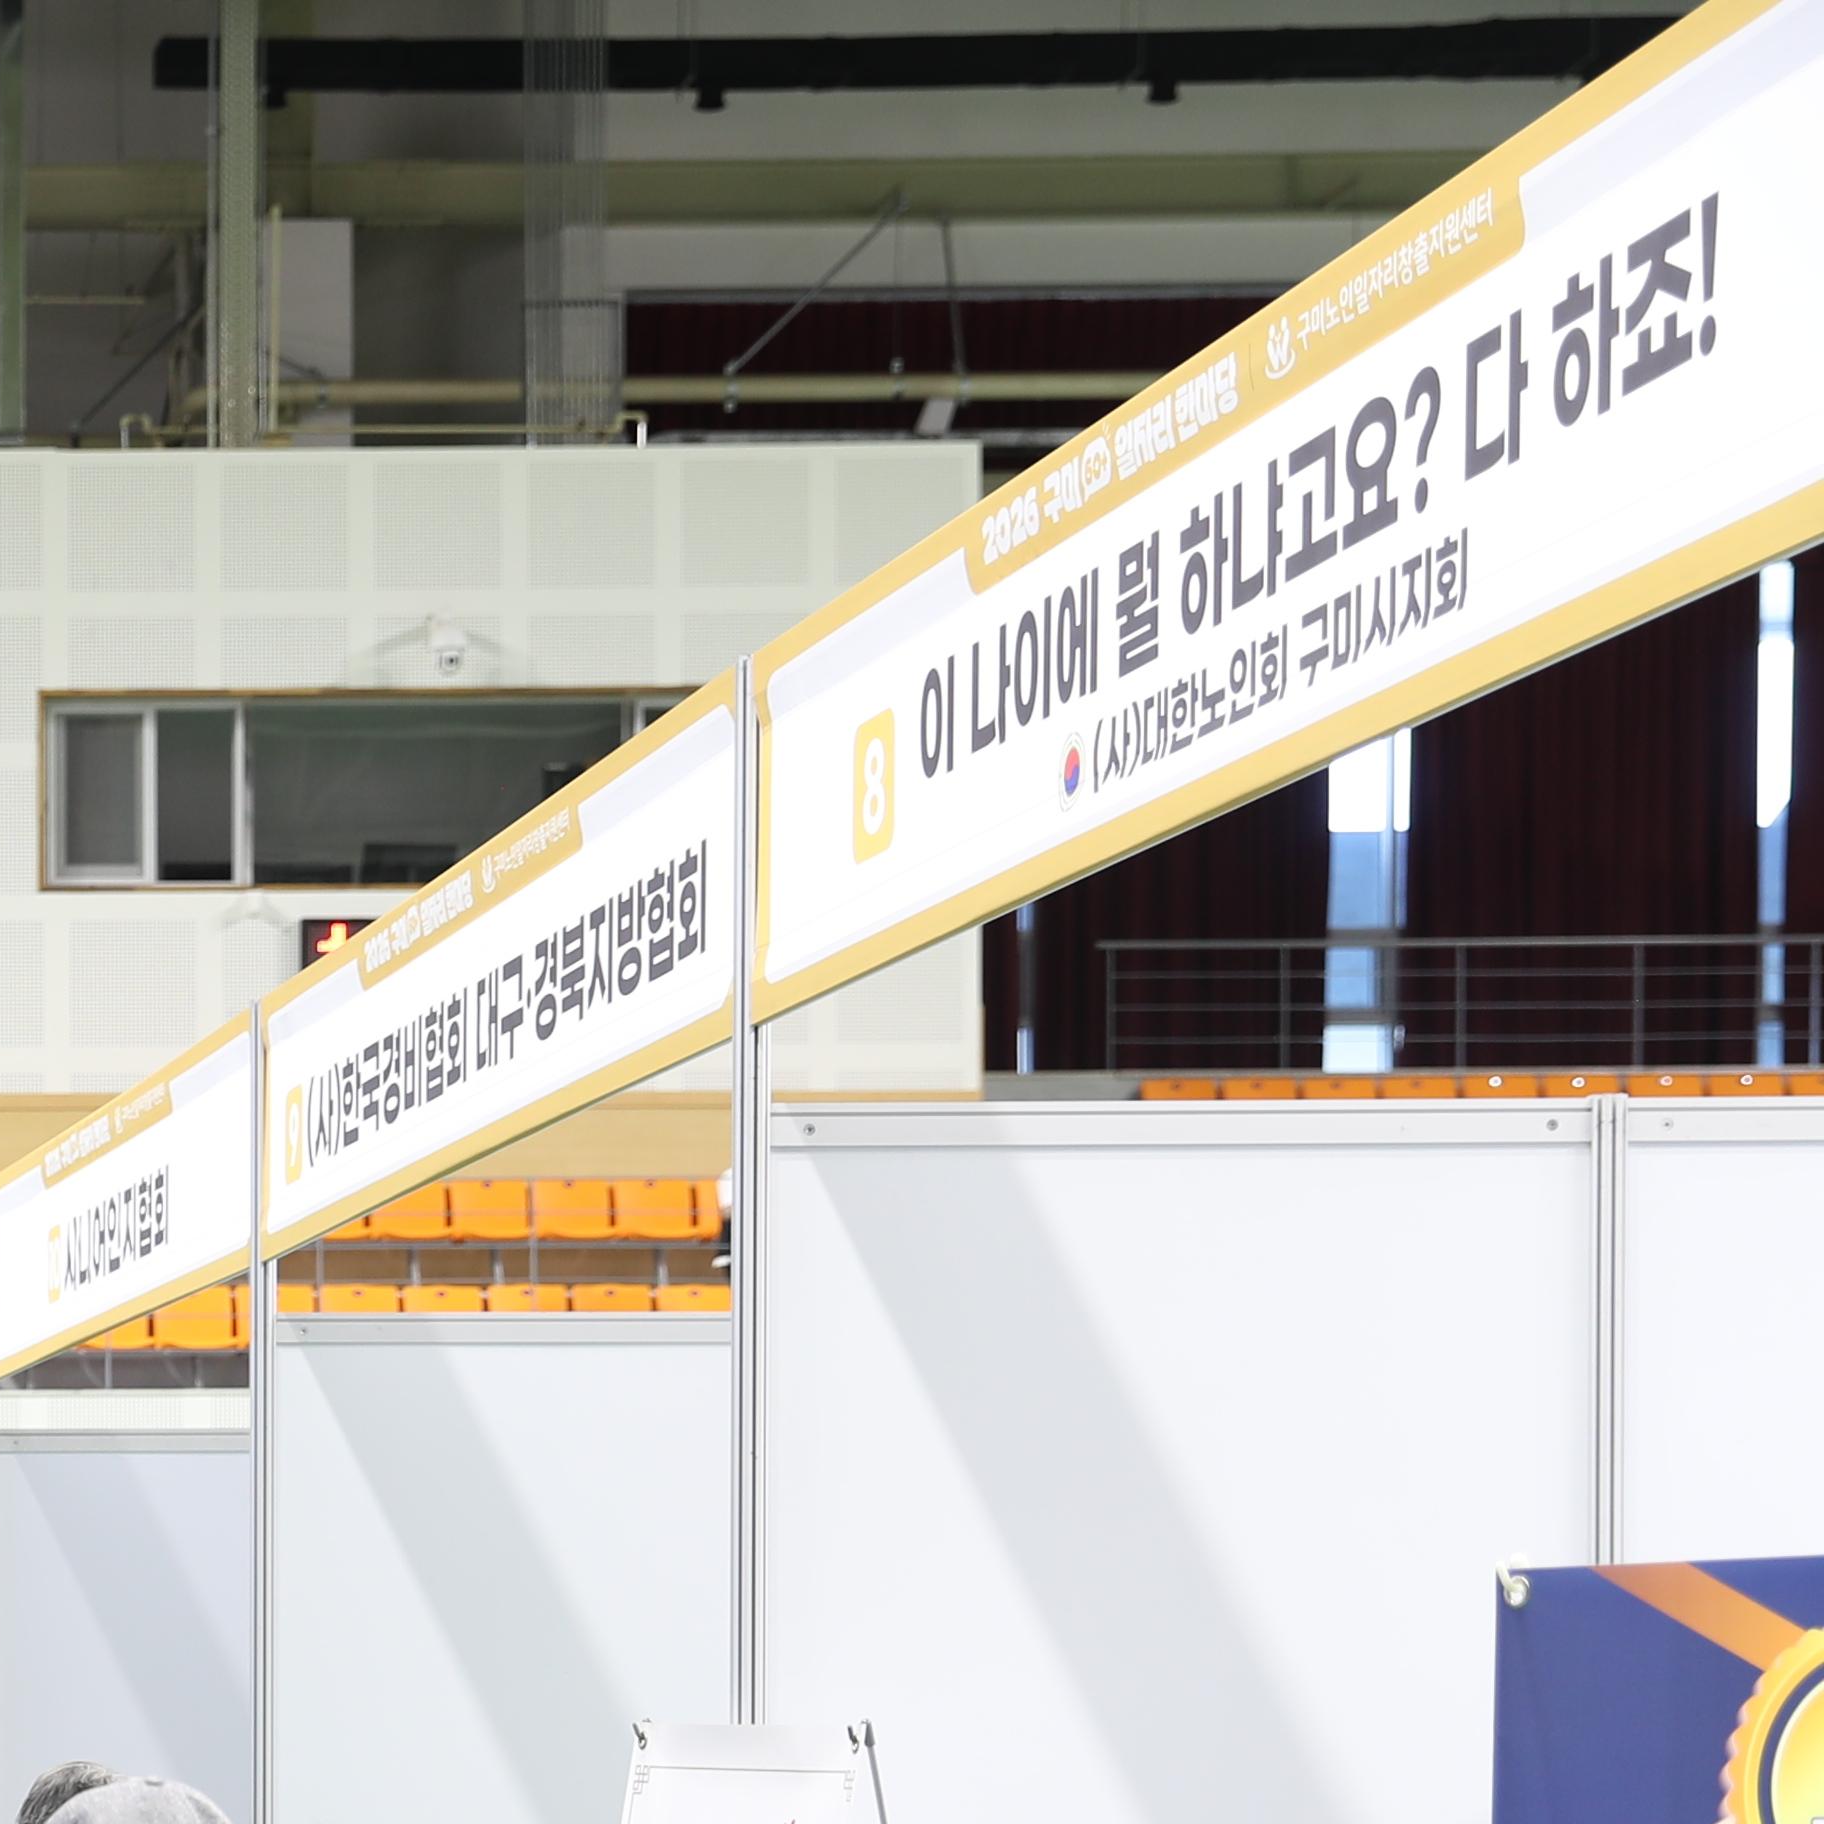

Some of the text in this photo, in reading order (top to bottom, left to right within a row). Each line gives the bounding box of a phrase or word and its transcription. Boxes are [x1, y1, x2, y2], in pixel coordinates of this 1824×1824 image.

[1295, 187, 1494, 350] 구미노인일자리창출지원센터
[921, 191, 1721, 779] 이 나이에 뭘 하냐고요? 다 하죠!
[981, 486, 1039, 565] 2026
[1043, 457, 1082, 524] 구미
[1113, 405, 1175, 480] 일자리
[1174, 353, 1239, 439] 한마당
[1092, 526, 1468, 794] (사)대한노인회 구미시지회
[861, 737, 887, 837] 8
[287, 1102, 299, 1168] 9
[307, 987, 468, 1167] (사)한국경비협회
[64, 1164, 169, 1291] 시니어인지협회
